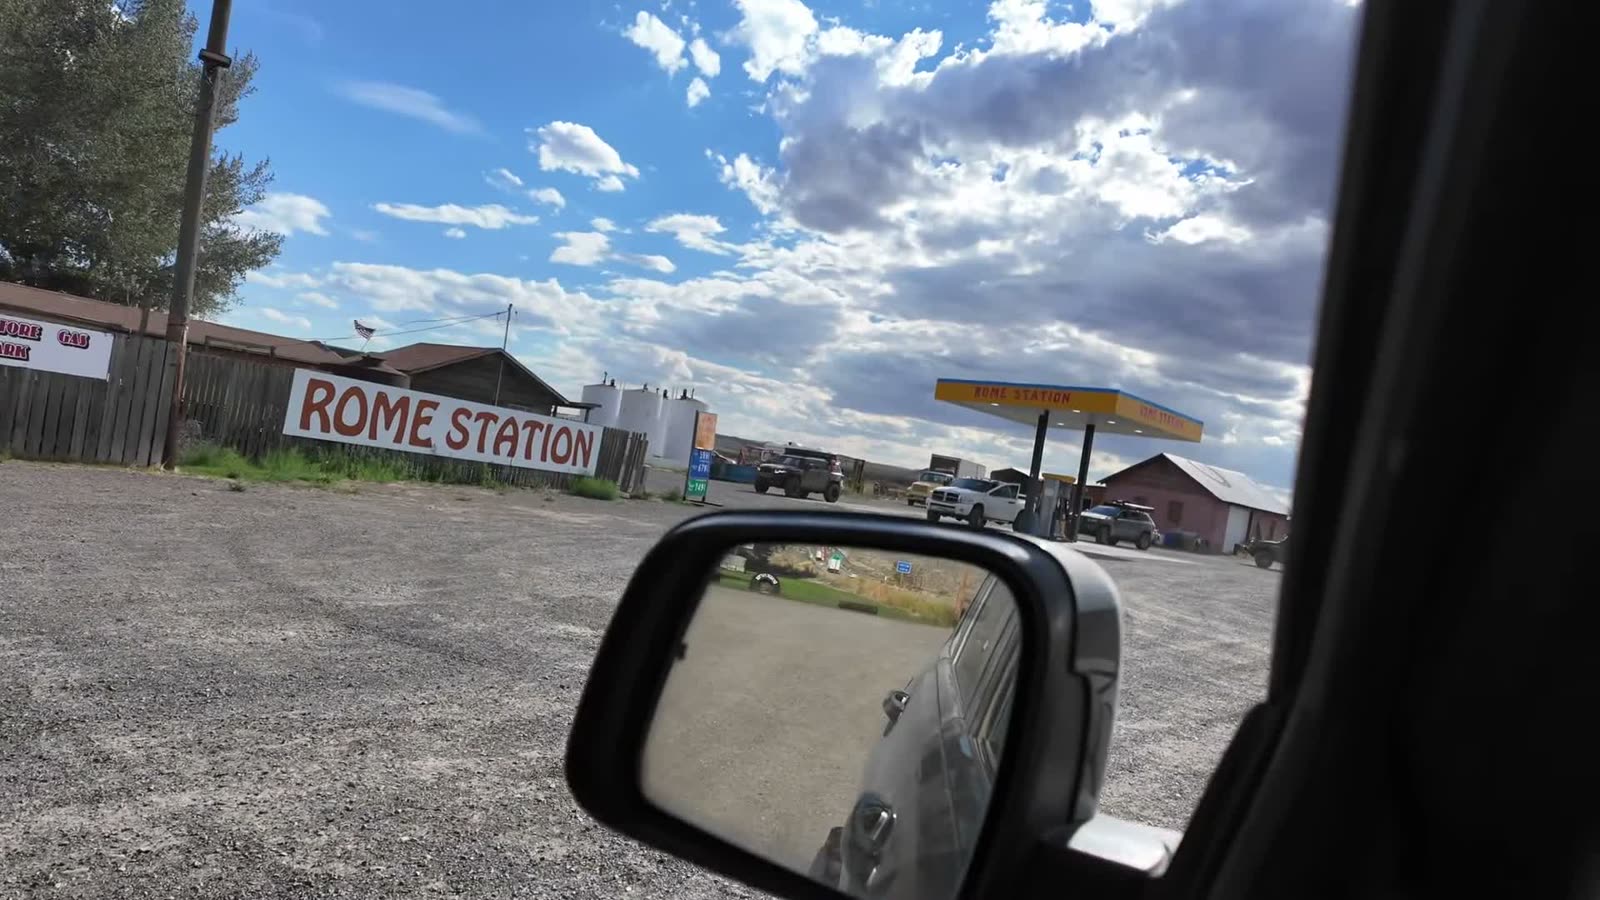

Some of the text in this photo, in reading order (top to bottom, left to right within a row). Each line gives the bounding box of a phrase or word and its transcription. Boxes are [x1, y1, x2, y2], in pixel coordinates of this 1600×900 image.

[57, 328, 90, 349] GAS
[974, 386, 1072, 404] ROME STATION
[300, 378, 594, 468] ROME STATION
